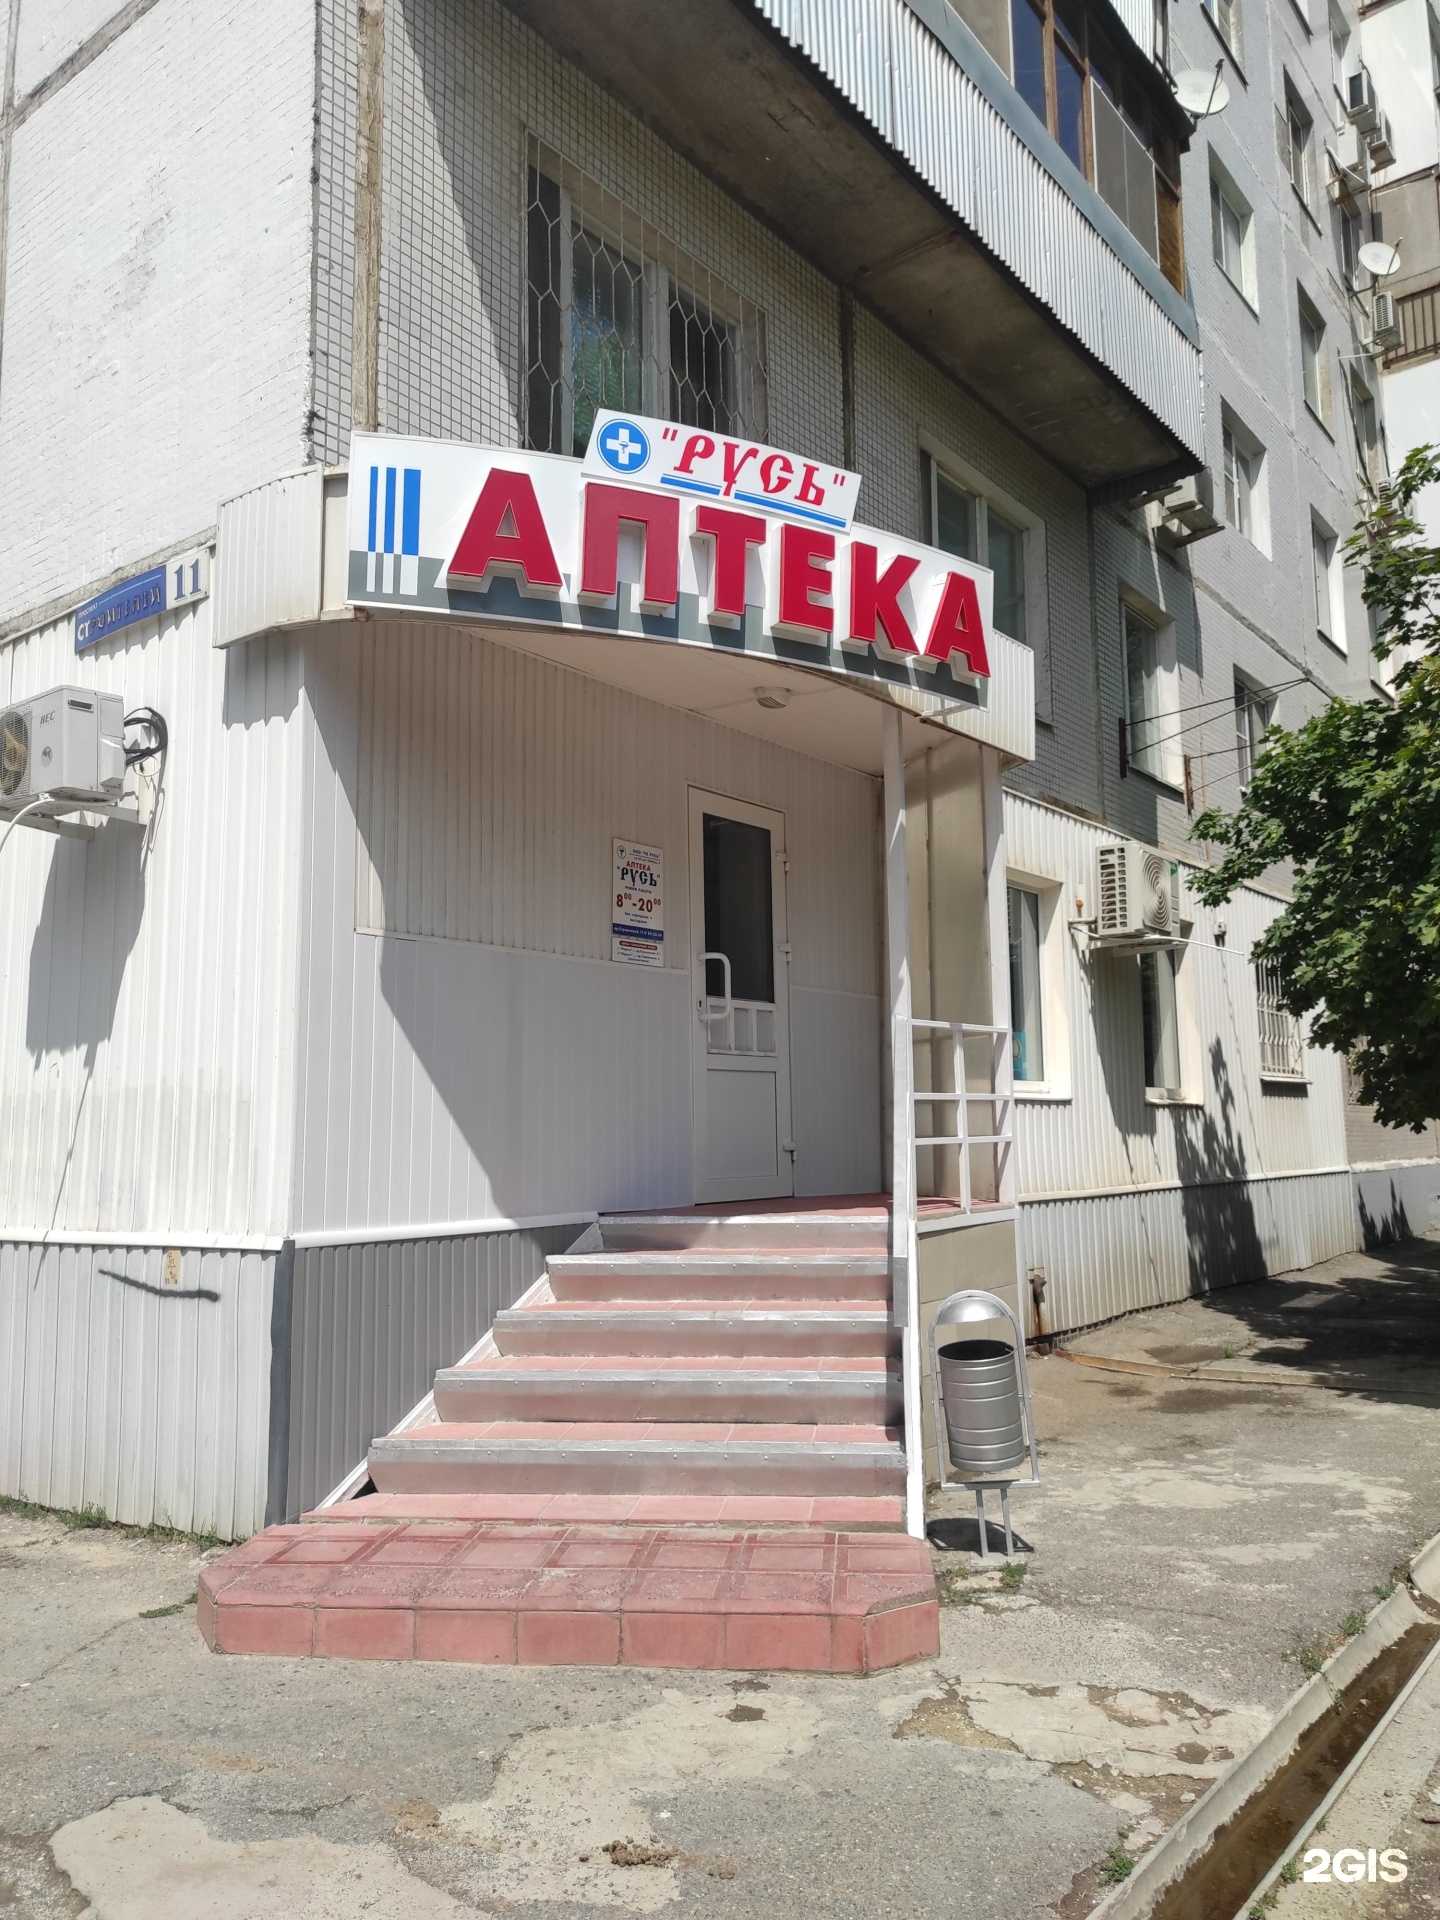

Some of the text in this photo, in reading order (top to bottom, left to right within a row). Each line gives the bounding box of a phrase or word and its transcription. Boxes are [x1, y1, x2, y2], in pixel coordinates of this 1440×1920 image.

[174, 558, 201, 601] 11
[446, 467, 991, 678] АПТЕКА
[625, 860, 651, 871] АПТЕКА
